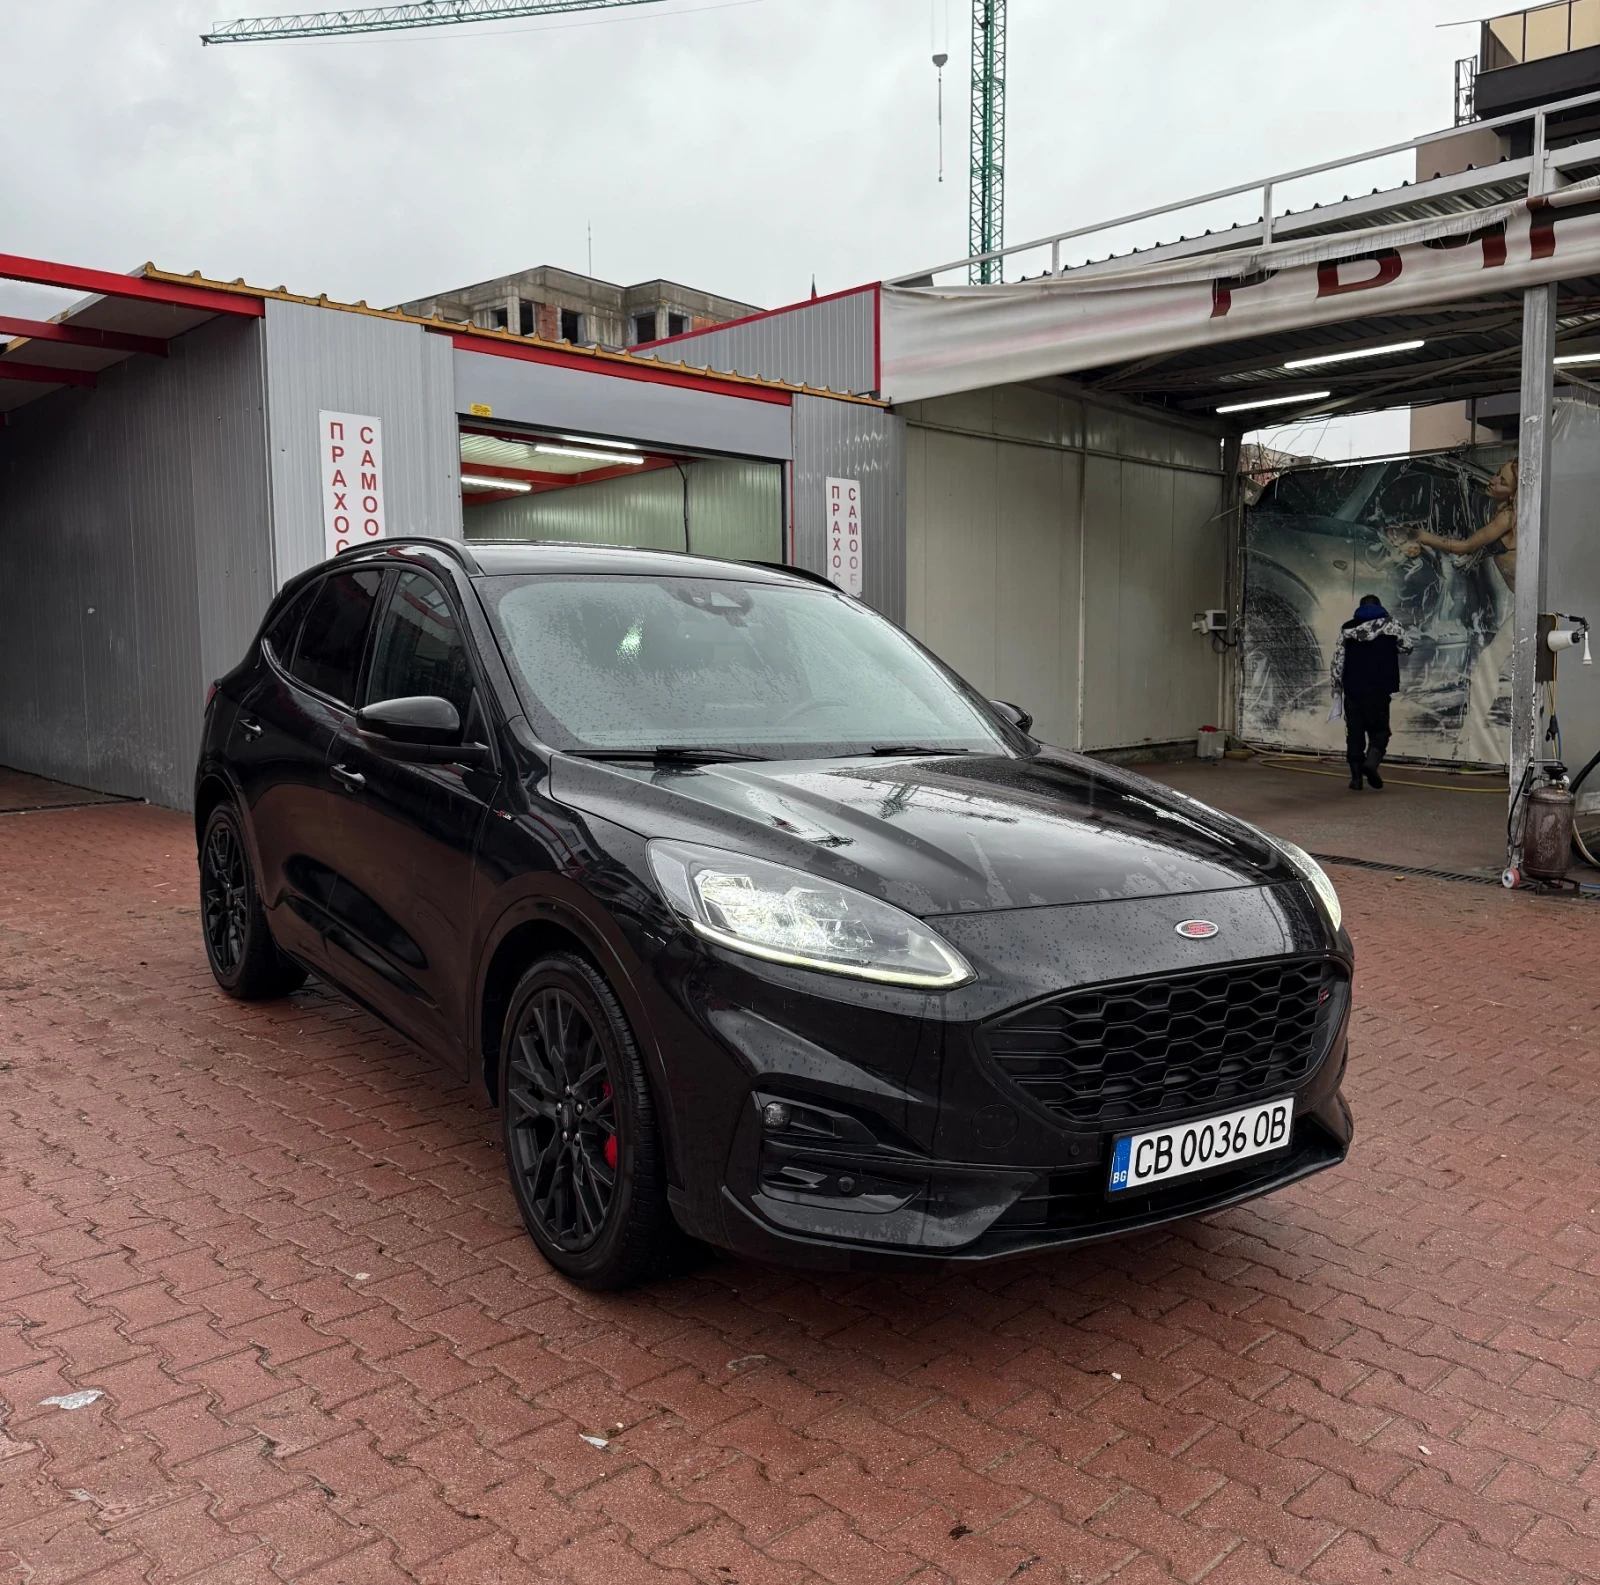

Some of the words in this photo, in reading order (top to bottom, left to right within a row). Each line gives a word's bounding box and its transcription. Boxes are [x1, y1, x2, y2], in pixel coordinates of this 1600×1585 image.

[360, 426, 379, 536] САМОО
[1112, 1170, 1127, 1184] BG
[1134, 1135, 1173, 1178] CB
[1180, 1116, 1247, 1167] 0036
[1253, 1105, 1287, 1147] OB
